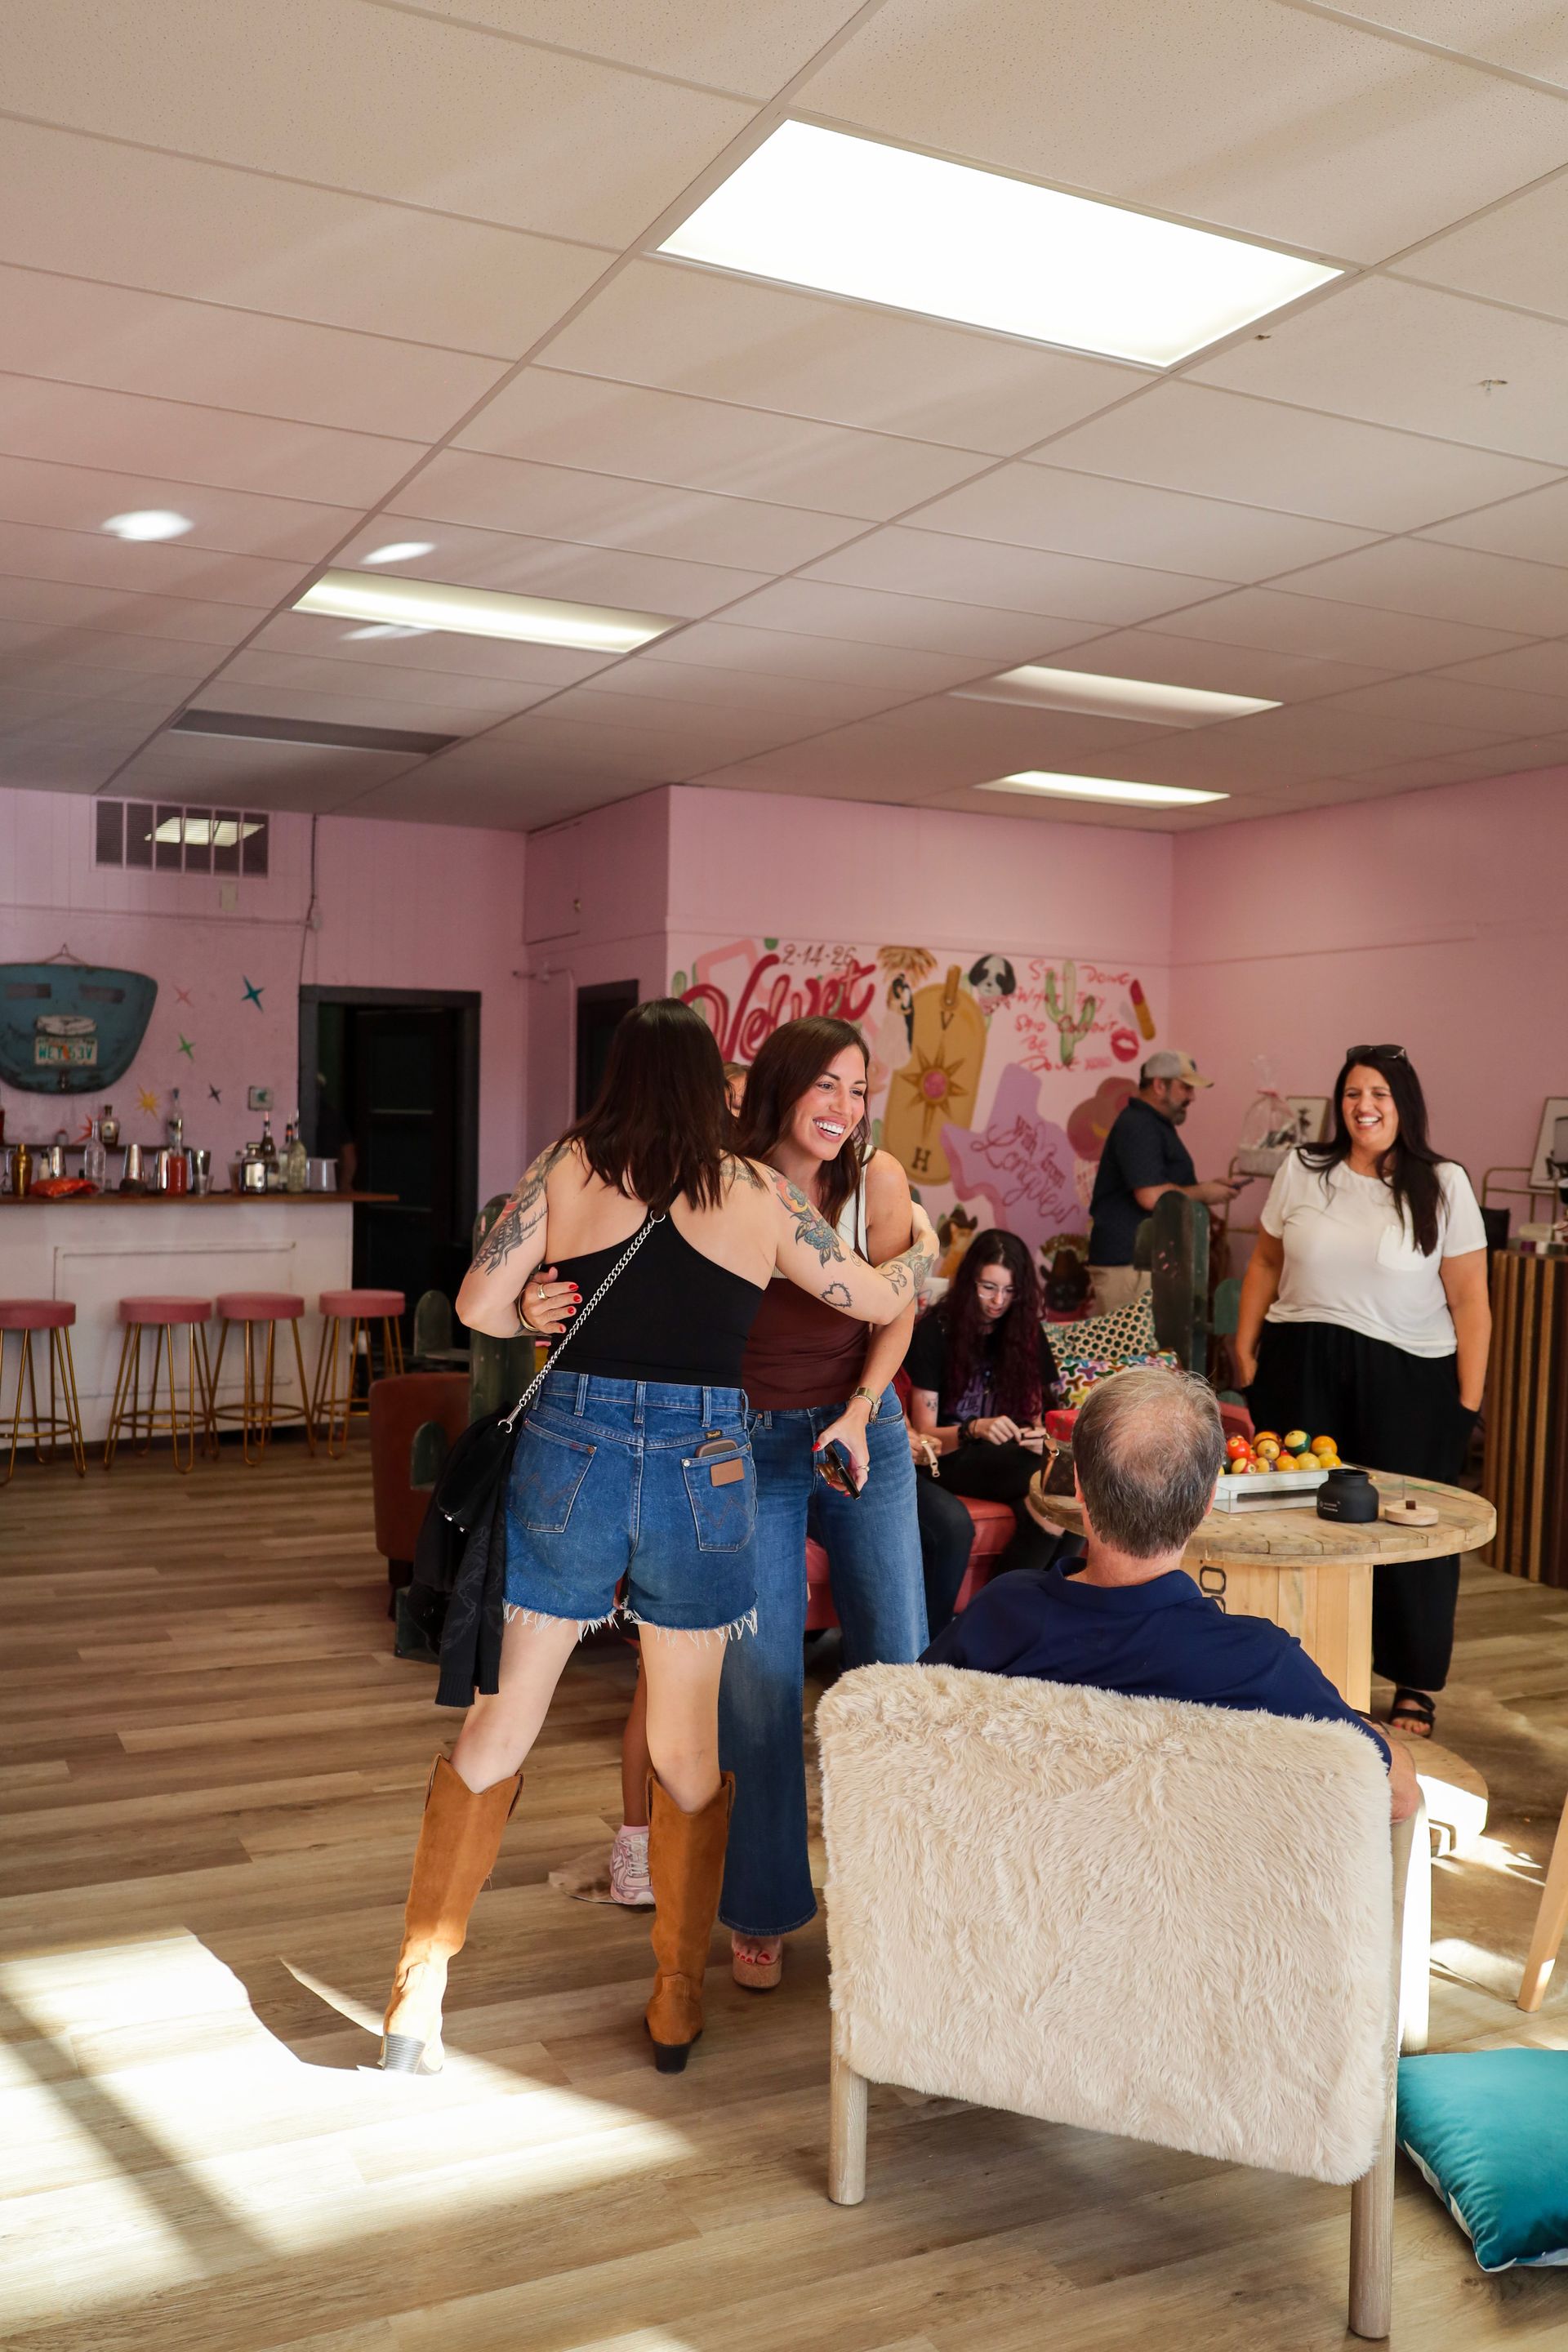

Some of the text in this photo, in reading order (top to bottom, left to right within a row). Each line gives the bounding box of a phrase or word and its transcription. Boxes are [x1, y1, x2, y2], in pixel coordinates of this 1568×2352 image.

[679, 954, 876, 1062] Velvet
[941, 1011, 955, 1031] V
[911, 1147, 931, 1172] H
